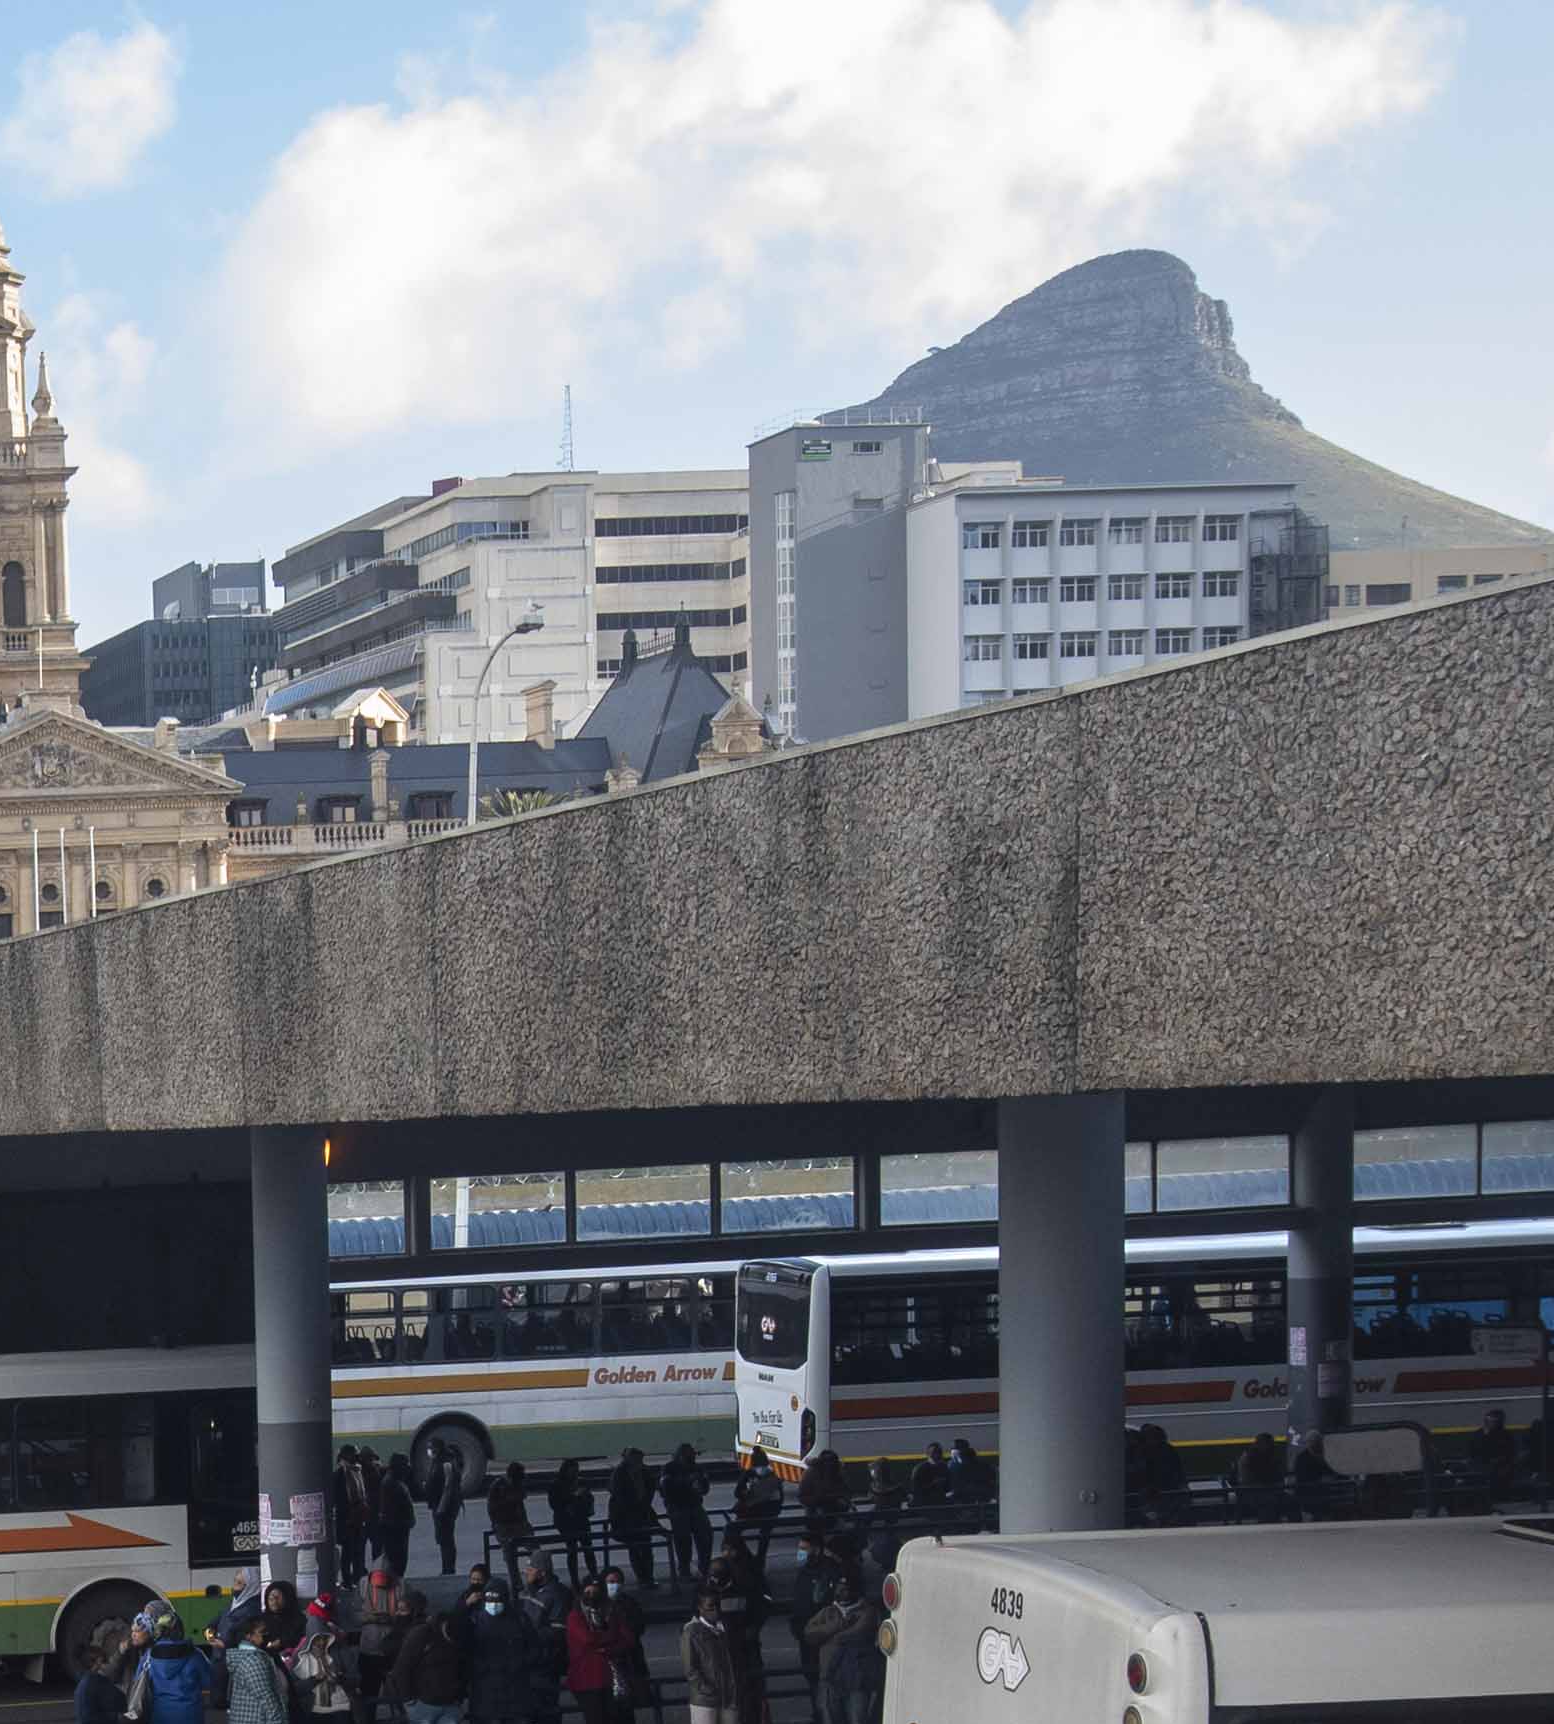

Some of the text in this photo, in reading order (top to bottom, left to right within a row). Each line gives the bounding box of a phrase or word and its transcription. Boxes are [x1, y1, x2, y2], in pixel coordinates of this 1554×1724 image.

[593, 1364, 718, 1385] Golden Arrow
[990, 1586, 1024, 1620] 4839
